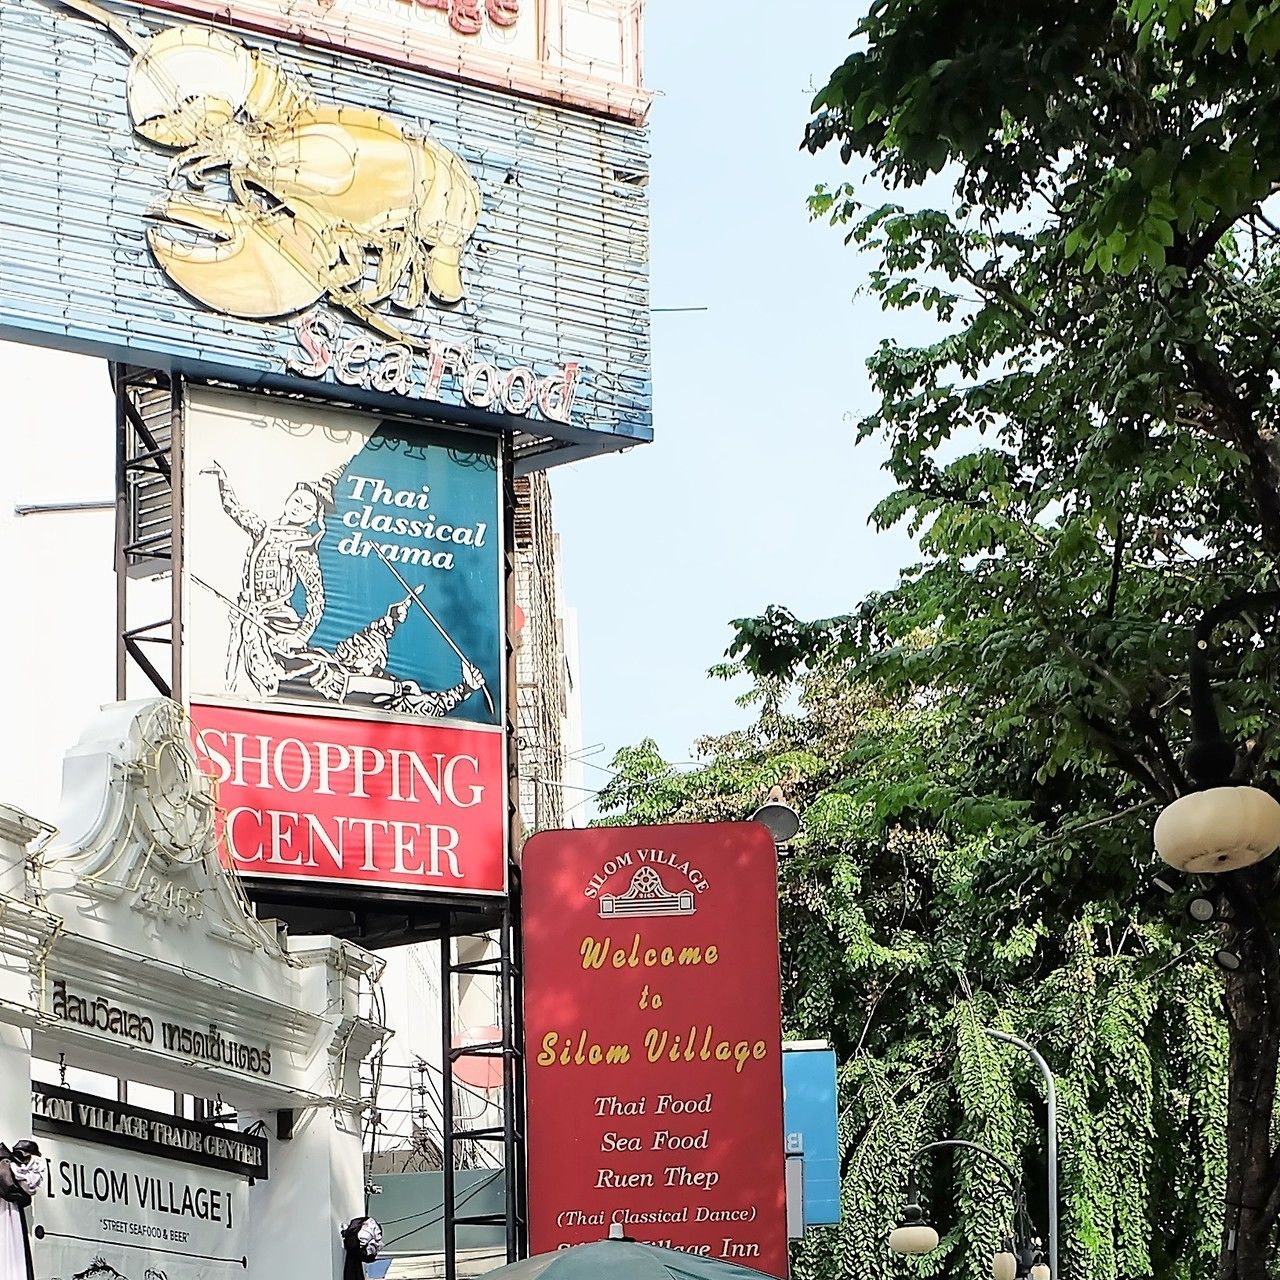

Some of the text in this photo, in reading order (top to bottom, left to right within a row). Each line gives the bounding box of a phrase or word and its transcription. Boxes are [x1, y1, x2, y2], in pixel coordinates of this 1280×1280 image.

[346, 474, 431, 511] Thai
[342, 506, 488, 549] classical
[337, 531, 456, 571] drama
[196, 727, 486, 809] SHOPPING
[226, 805, 466, 880] CENTER
[584, 848, 711, 900] SILOM VILLAGE
[579, 933, 720, 971] Welcome
[638, 984, 664, 1011] to
[536, 1025, 768, 1075] Silom Village
[594, 1093, 713, 1117] Thai Food
[78, 1103, 149, 1141] VILLAGE
[150, 1120, 203, 1154] TRADE
[204, 1135, 263, 1167] CENTER
[600, 1129, 710, 1153] Sea Food
[59, 1160, 130, 1206] SILOM
[134, 1174, 222, 1223] VILLAGE
[594, 1165, 720, 1191] Ruen Thep
[129, 1222, 162, 1240] SEAFOOD
[162, 1229, 169, 1240] &
[556, 1205, 758, 1228] (Thai Classical Dance)
[720, 1238, 761, 1258] Inn
